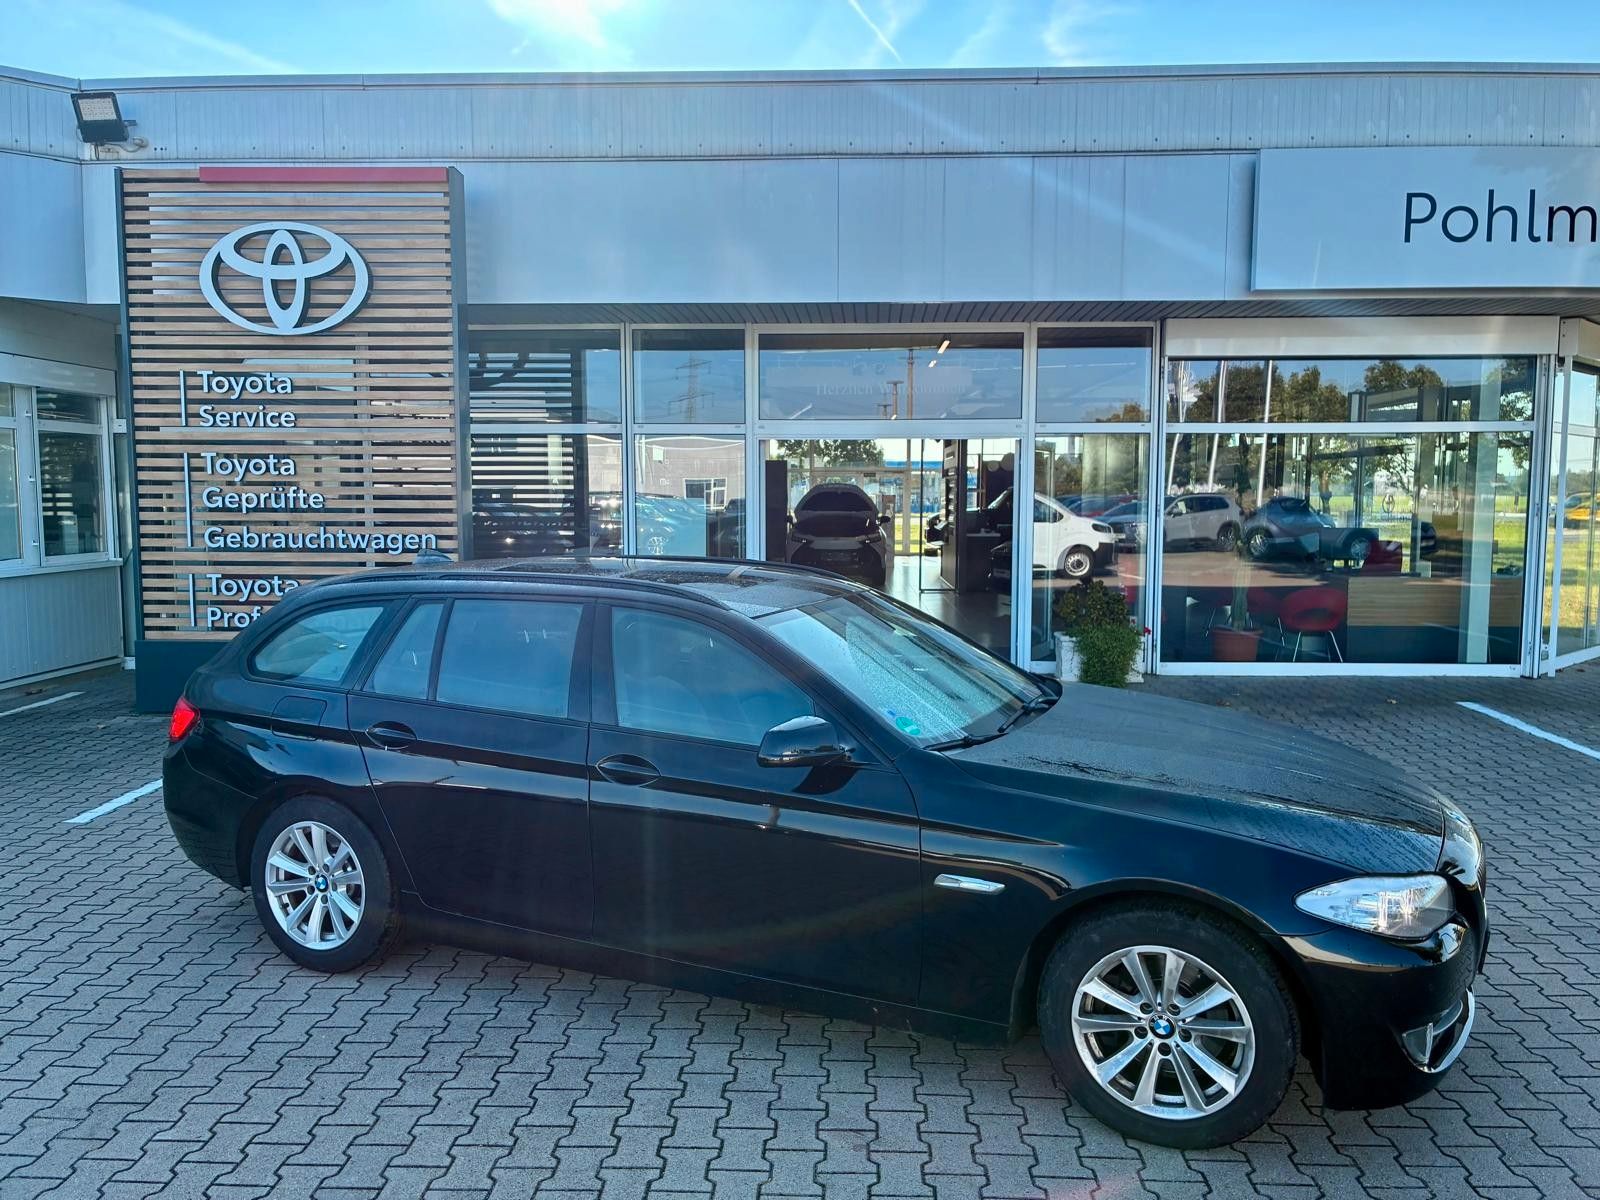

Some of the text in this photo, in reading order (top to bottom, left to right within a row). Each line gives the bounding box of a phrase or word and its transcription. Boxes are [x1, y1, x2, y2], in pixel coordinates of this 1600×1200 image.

[1403, 188, 1598, 243] Pohlm
[197, 370, 293, 400] Toyota
[199, 405, 297, 428] Service
[201, 452, 296, 482] Toyota
[202, 487, 326, 513] Geprüfte
[204, 527, 438, 554] Gebrauchtwagen
